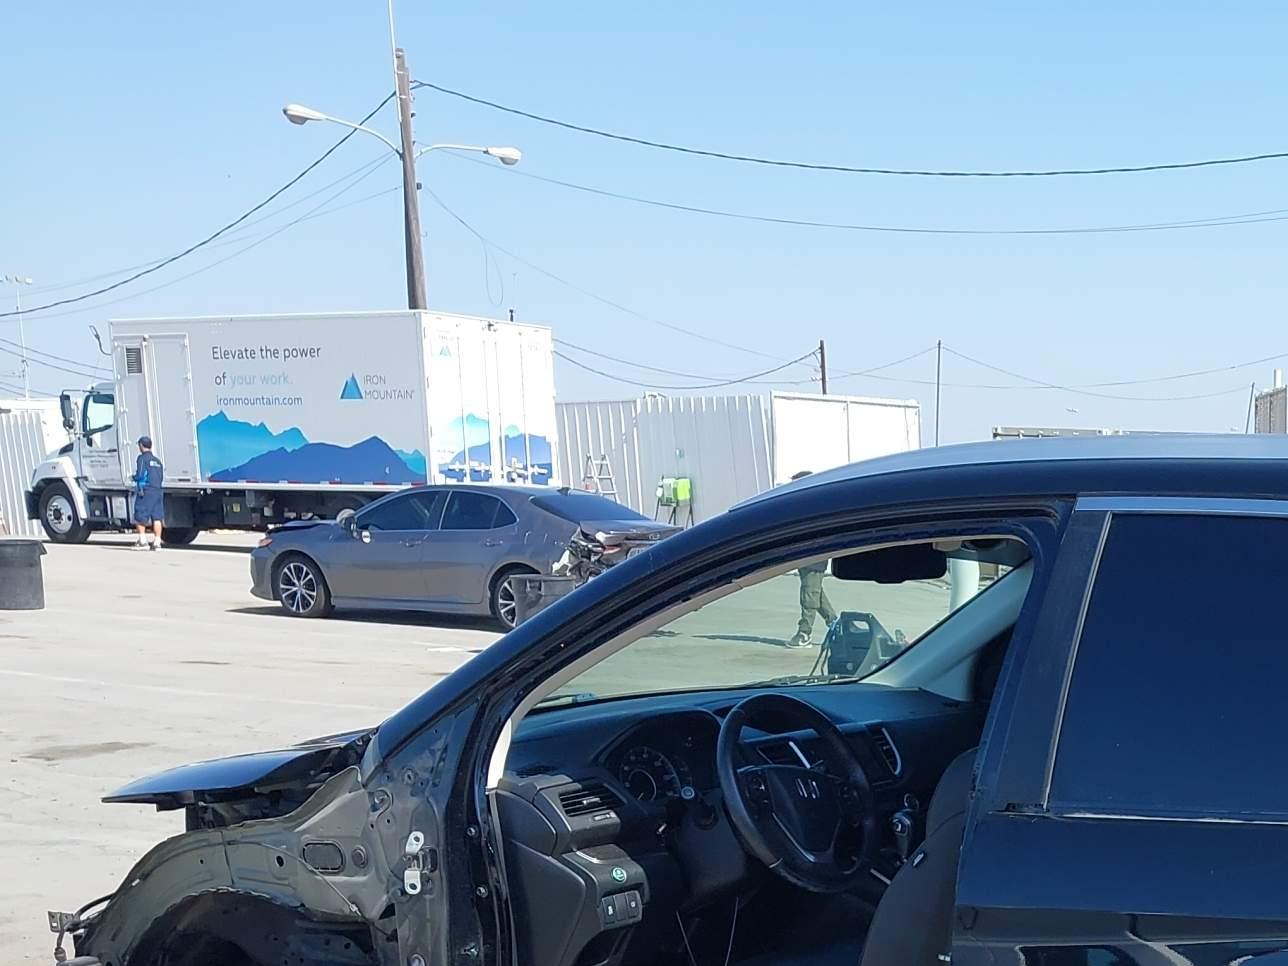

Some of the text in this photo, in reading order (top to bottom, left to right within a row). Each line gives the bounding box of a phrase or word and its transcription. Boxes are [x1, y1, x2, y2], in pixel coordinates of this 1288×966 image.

[211, 345, 321, 363] Elevate the power
[214, 371, 227, 386] of
[230, 375, 257, 389] your
[363, 375, 386, 385] IRON
[216, 394, 303, 407] ironmountain.com
[364, 389, 413, 400] MOUNTAIN
